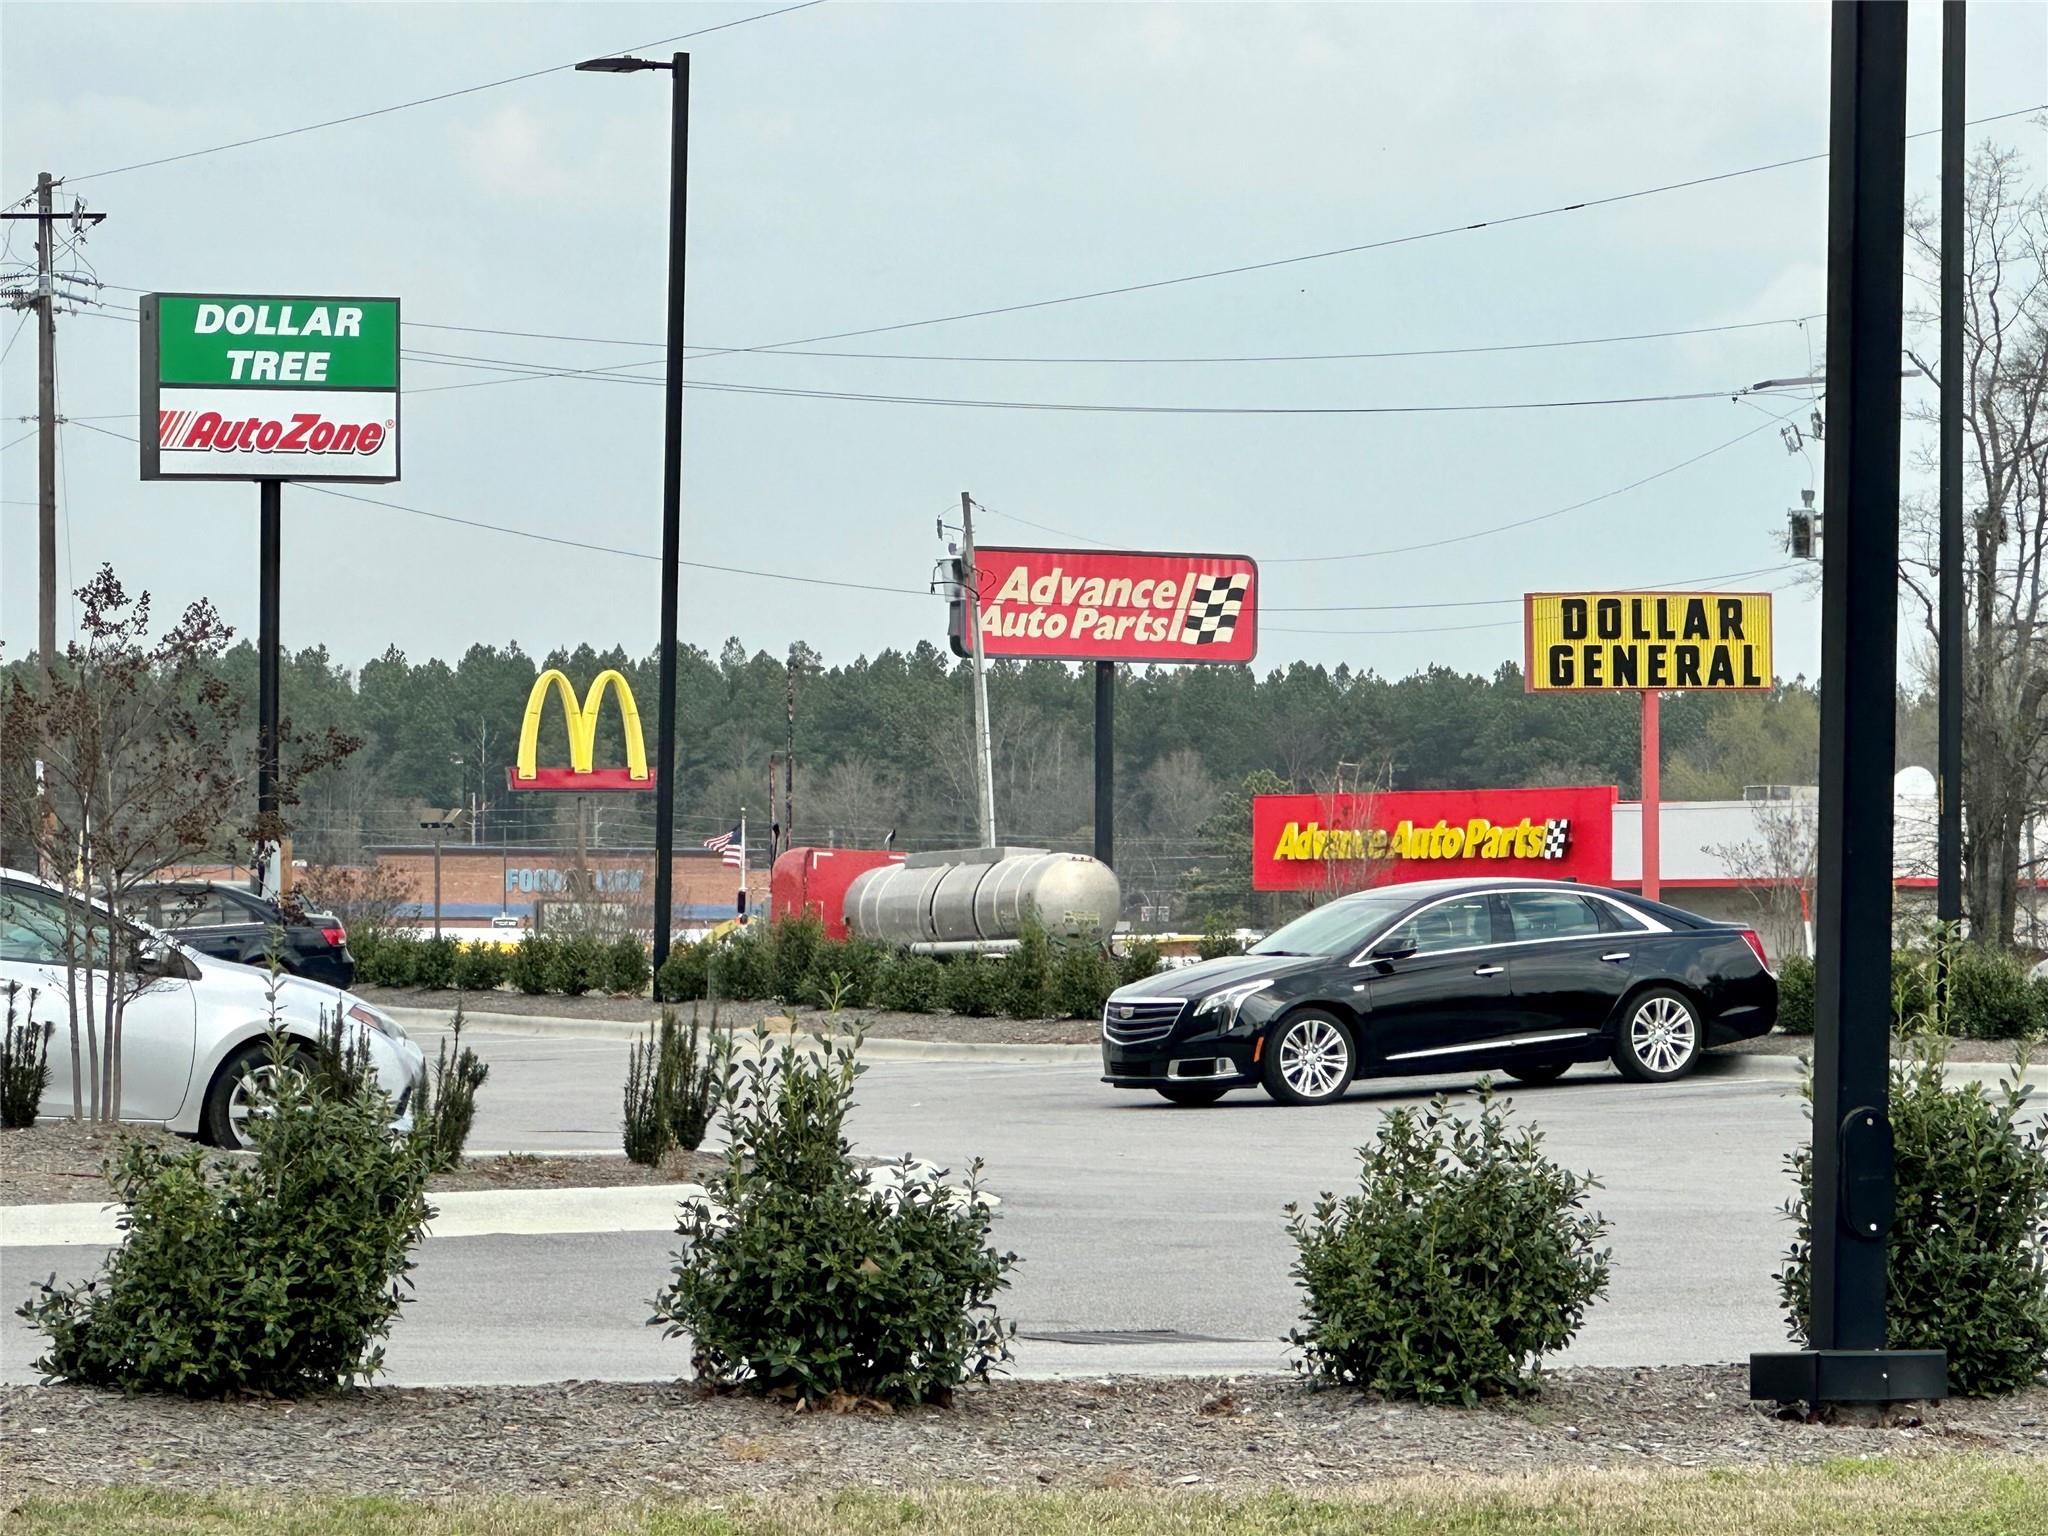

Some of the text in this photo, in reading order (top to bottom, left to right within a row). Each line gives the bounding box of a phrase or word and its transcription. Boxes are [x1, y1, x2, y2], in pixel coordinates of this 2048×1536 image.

[194, 304, 363, 337] DOLLAR
[226, 350, 331, 382] TREE
[181, 411, 386, 455] AutoZone
[993, 565, 1178, 609] Advance
[979, 604, 1169, 642] Auto Parts
[1561, 598, 1745, 640] DOLLAR
[1549, 644, 1762, 687] GENERAL
[1273, 817, 1544, 860] Advance Auto Parts
